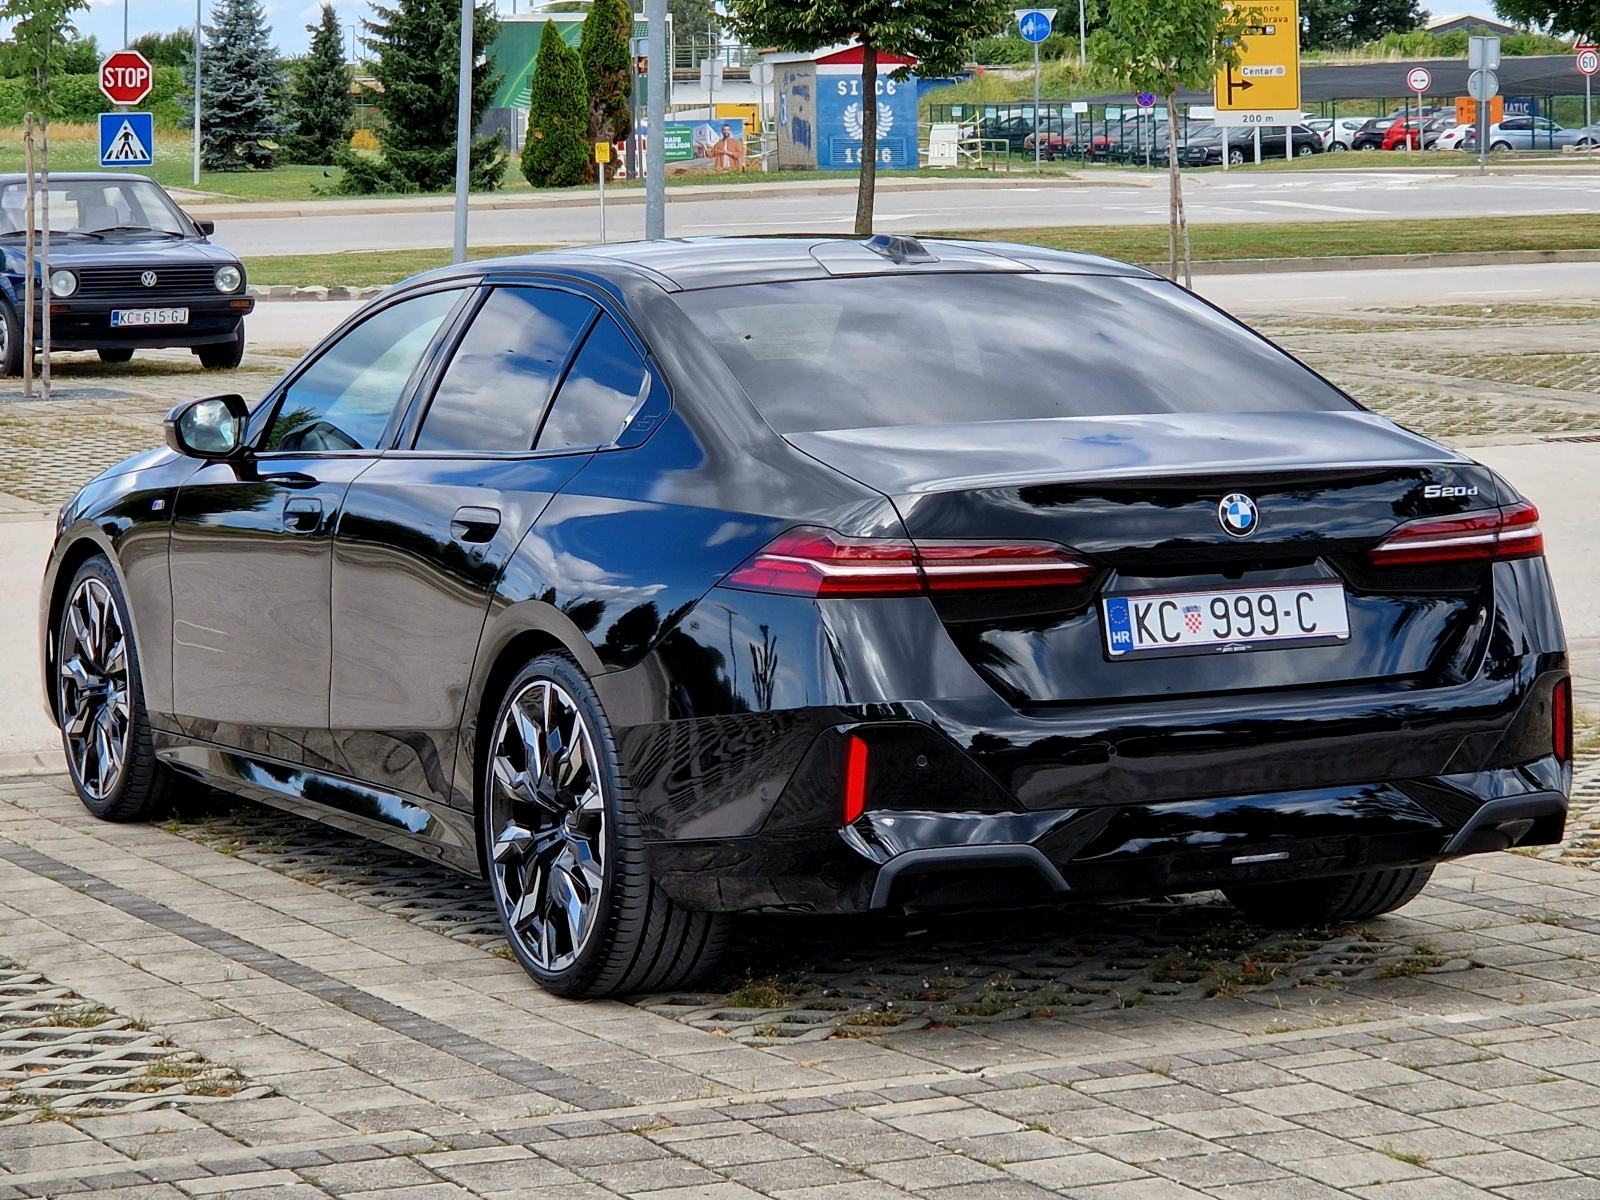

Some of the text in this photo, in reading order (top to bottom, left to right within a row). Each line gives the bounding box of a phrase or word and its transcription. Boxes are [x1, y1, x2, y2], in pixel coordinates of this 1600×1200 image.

[1582, 56, 1595, 68] 60
[104, 67, 148, 88] STOP
[1242, 67, 1274, 75] Centar
[837, 80, 897, 96] SICE
[1242, 114, 1274, 123] 200 m
[844, 147, 892, 163] 196
[141, 271, 157, 287] VW
[119, 312, 135, 325] KC
[143, 310, 187, 324] 615-GJ
[1423, 484, 1479, 499] 520d
[1134, 591, 1318, 645] KC 999-C
[1112, 630, 1131, 644] HR
